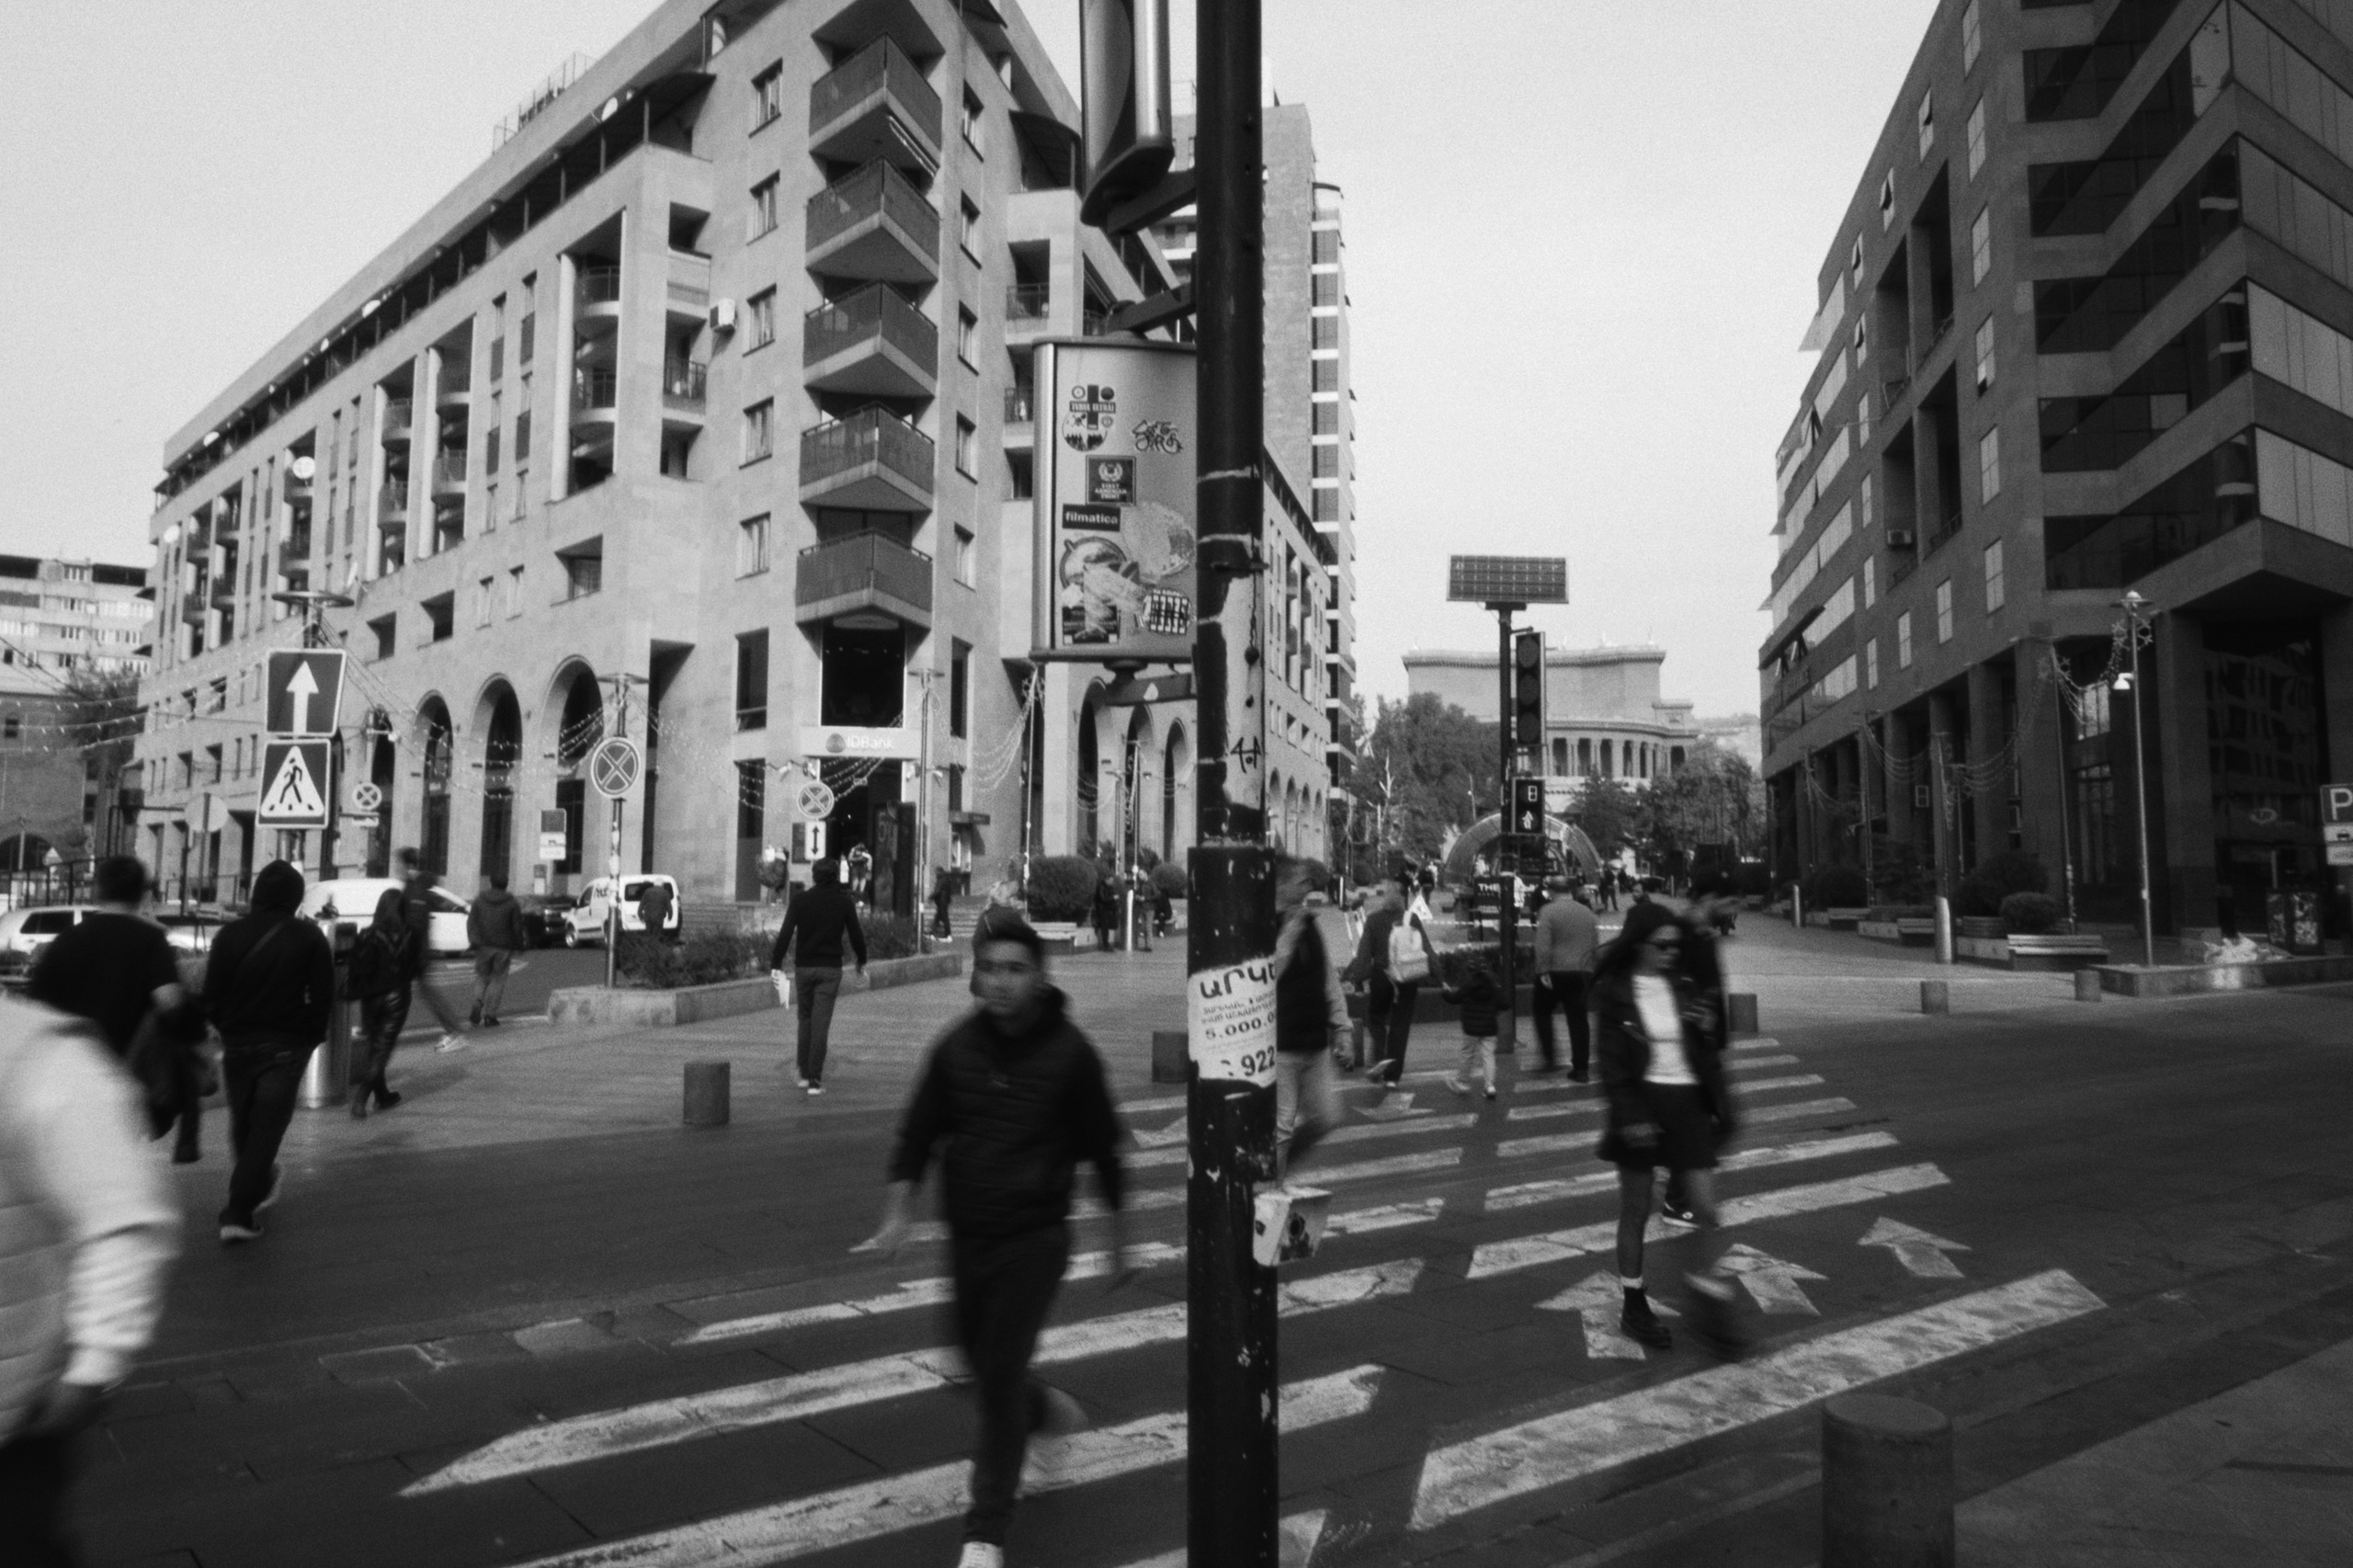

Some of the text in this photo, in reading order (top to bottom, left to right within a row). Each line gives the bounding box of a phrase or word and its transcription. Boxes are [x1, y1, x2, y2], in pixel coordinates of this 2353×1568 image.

[1065, 511, 1119, 525] filmatica
[847, 735, 894, 750] IDBank
[2329, 788, 2353, 821] P
